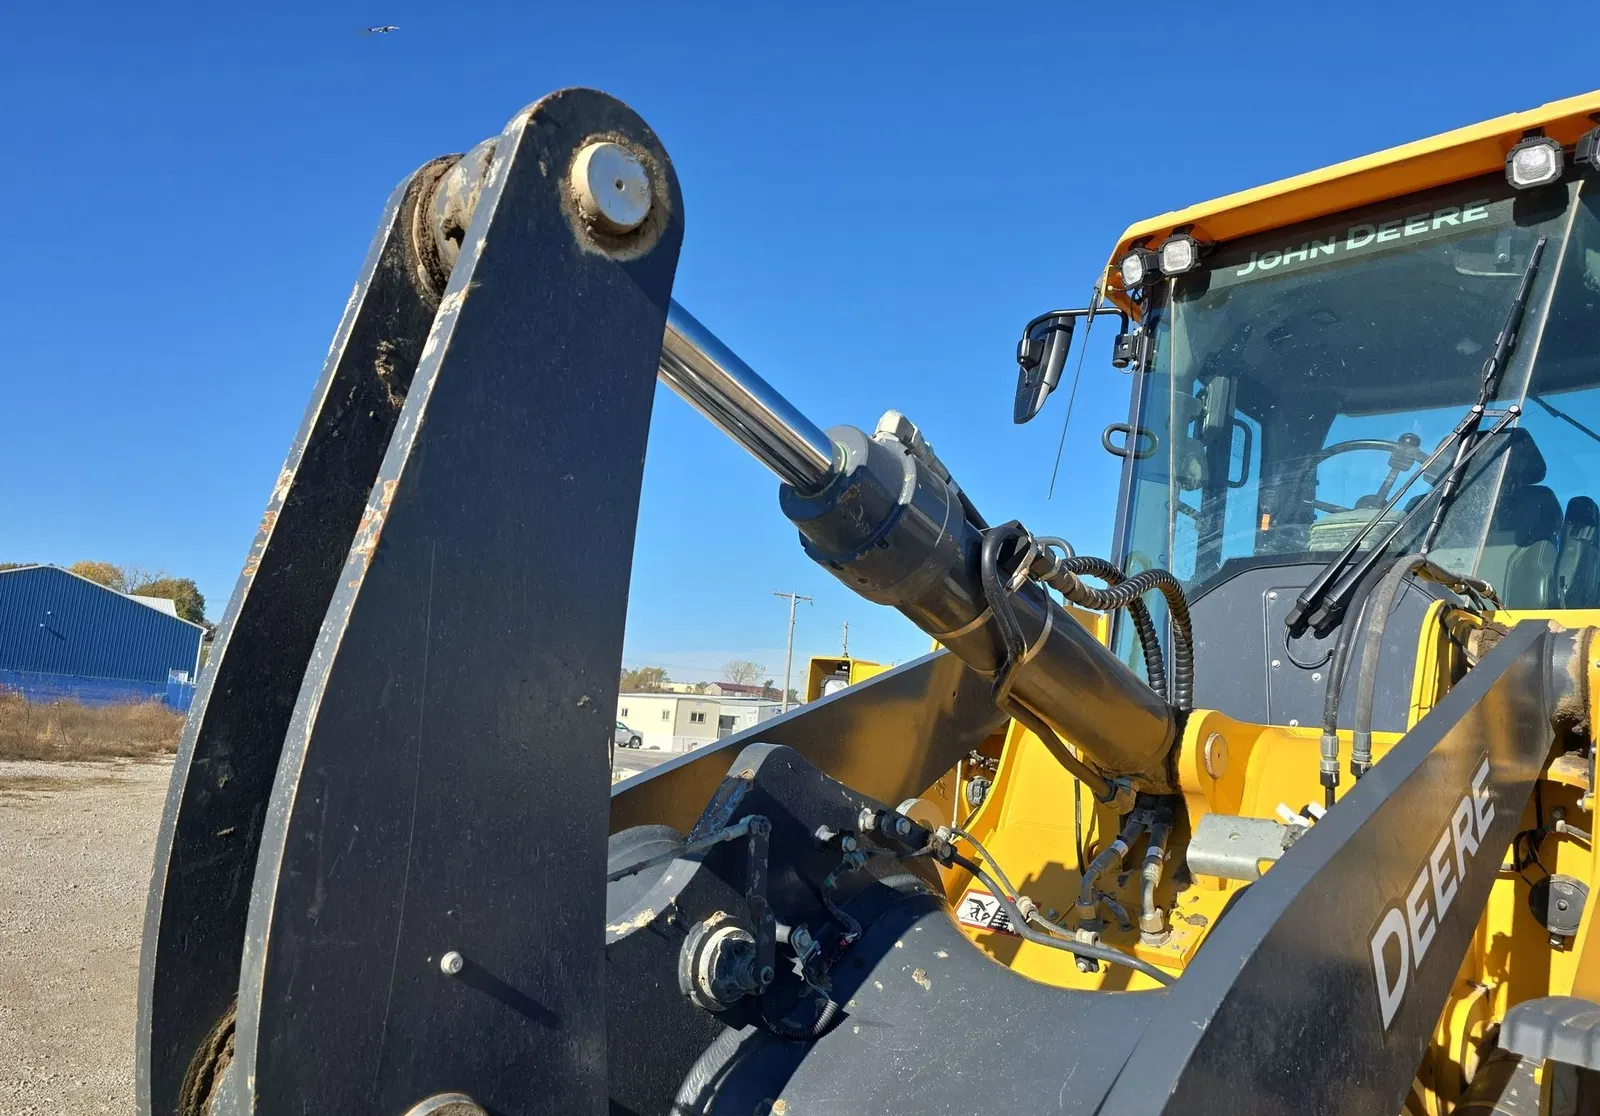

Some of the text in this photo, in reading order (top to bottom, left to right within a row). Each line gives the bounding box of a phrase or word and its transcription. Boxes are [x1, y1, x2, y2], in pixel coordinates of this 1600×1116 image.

[1236, 199, 1490, 277] JOHN DEERE
[1371, 757, 1496, 1032] DEERE
